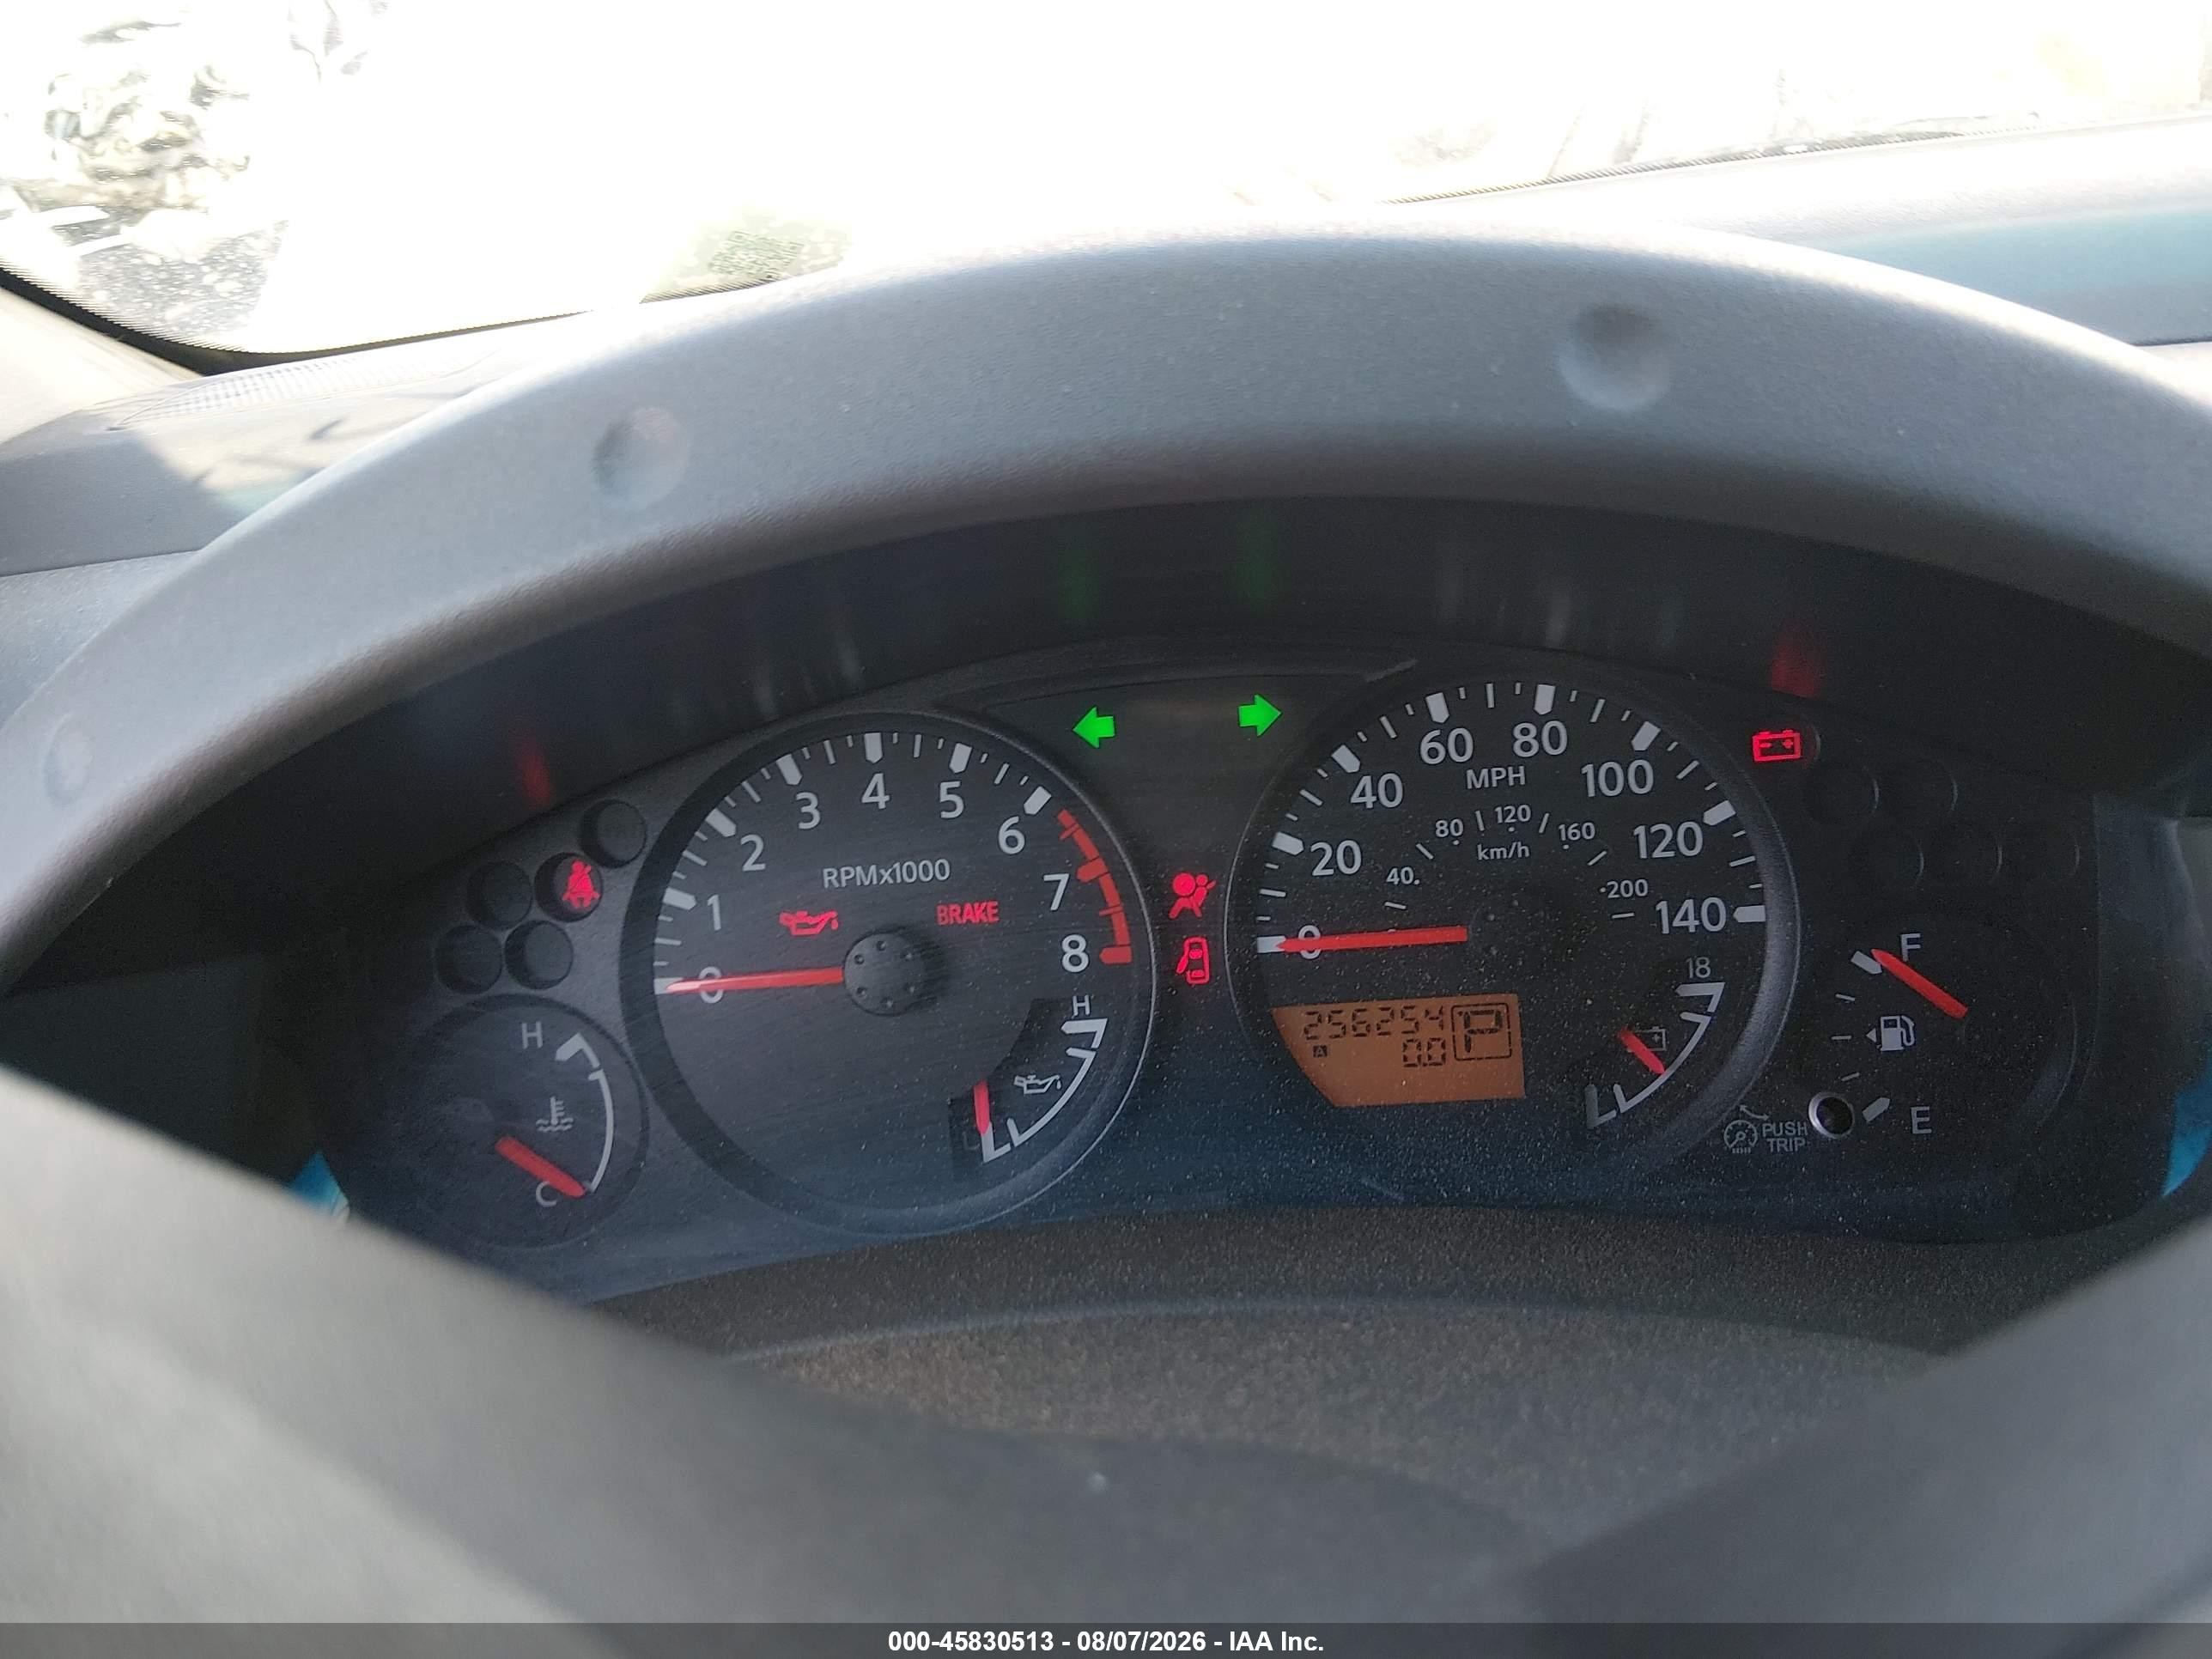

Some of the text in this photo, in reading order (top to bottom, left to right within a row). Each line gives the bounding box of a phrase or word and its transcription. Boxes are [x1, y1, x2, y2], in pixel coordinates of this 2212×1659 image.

[1419, 727, 1474, 764] 60
[1512, 720, 1567, 757] 80
[861, 773, 890, 810] 4
[1350, 773, 1403, 809] 40
[1466, 765, 1526, 789] MPH
[1581, 758, 1654, 797] 100
[796, 791, 821, 829] 3
[939, 781, 965, 818] 5
[1494, 805, 1531, 823] 120
[998, 817, 1025, 854] 6
[1435, 818, 1463, 838] 80
[1558, 821, 1595, 842] 160
[1633, 820, 1703, 859] 120
[741, 834, 766, 872] 2
[1310, 839, 1362, 876] 20
[1477, 841, 1529, 862] km/h
[823, 859, 951, 889] RPMx1000
[1607, 878, 1648, 898] 200
[1043, 873, 1070, 911] 7
[708, 894, 722, 930] 1
[936, 901, 999, 925] BRAKE
[1655, 896, 1726, 934] 140
[1060, 933, 1088, 972] 8
[1297, 925, 1321, 959] 0
[1900, 933, 1921, 961] F
[699, 965, 724, 1004] 0
[1687, 957, 1711, 978] 18
[1073, 995, 1091, 1017] H
[522, 1021, 543, 1048] H
[1304, 1006, 1502, 1053] 256254 P
[1762, 1121, 1808, 1138] PUSH
[1911, 1106, 1931, 1133] E
[1766, 1138, 1806, 1152] TRIP
[535, 1182, 558, 1207] C
